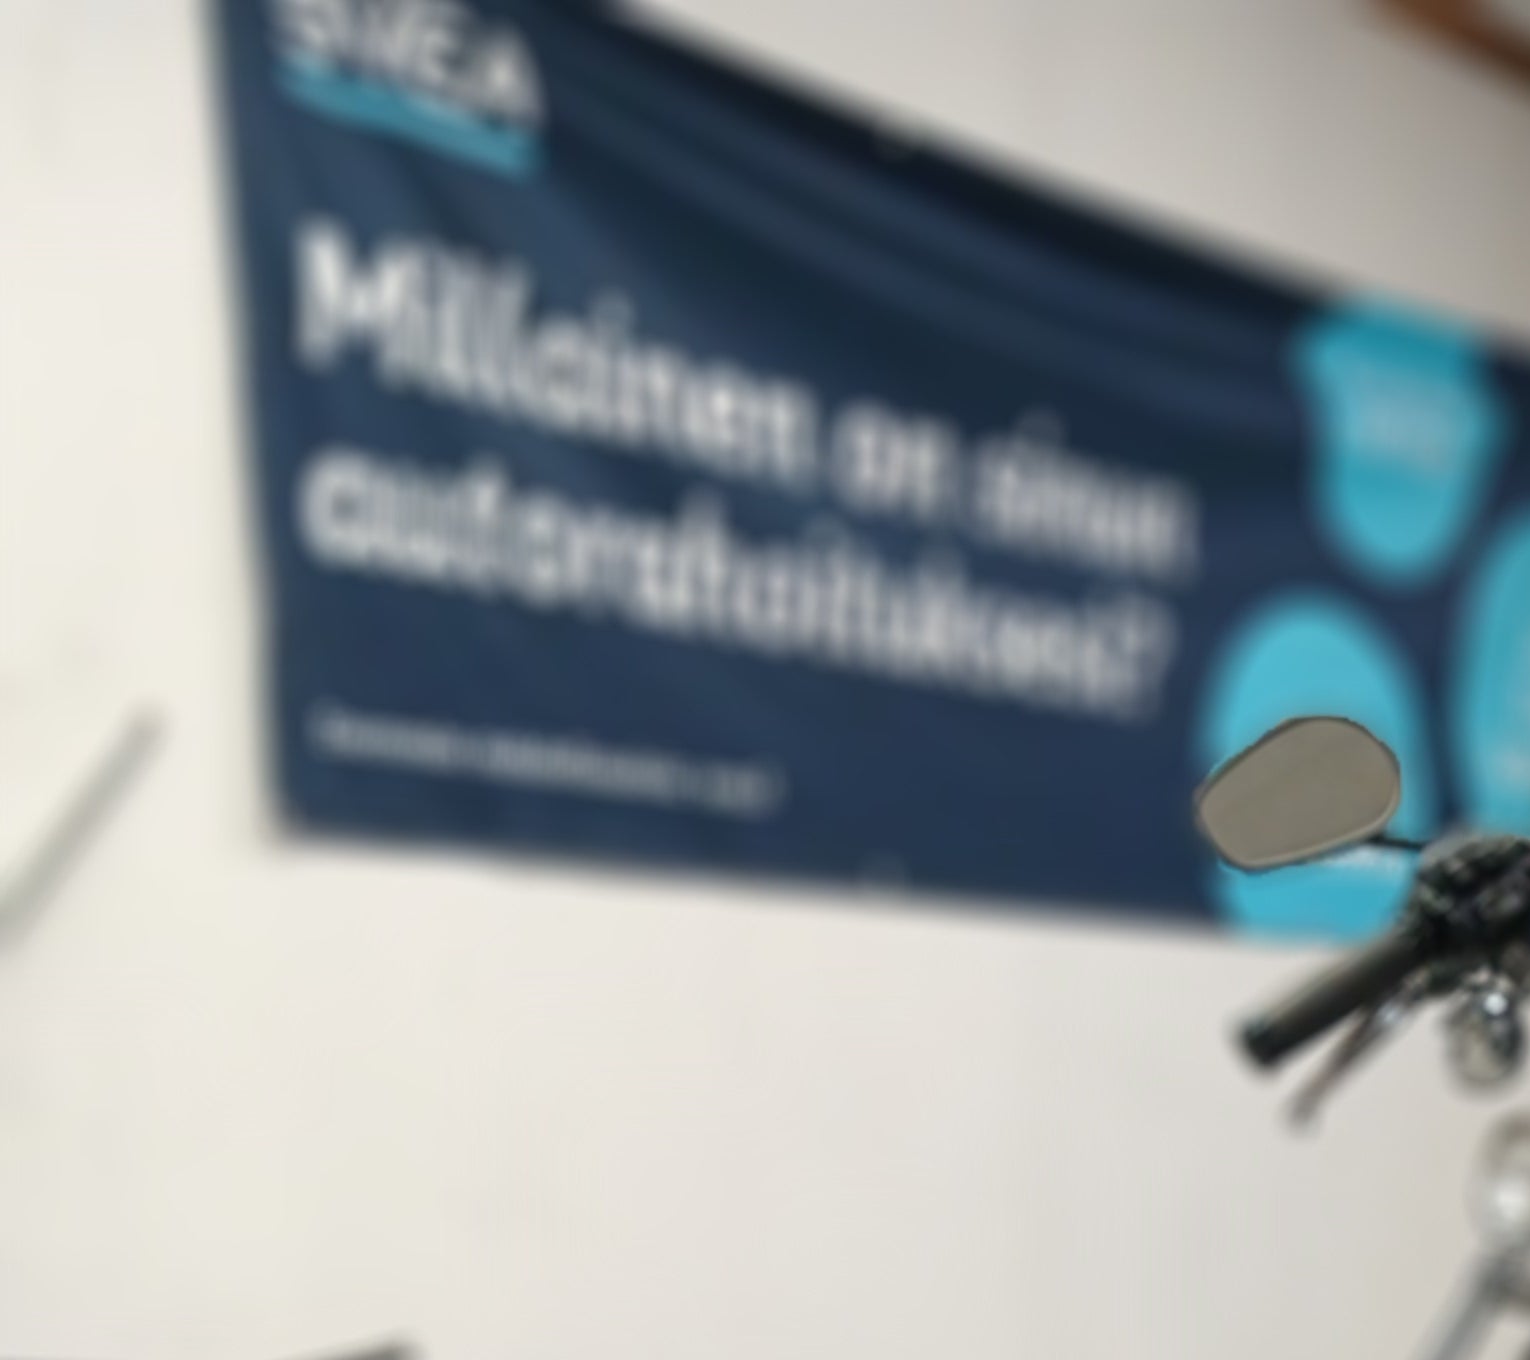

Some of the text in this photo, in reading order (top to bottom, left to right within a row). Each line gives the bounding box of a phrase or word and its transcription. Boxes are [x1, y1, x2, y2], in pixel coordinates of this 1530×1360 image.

[294, 218, 820, 492] Millainen
[832, 402, 960, 526] on
[972, 412, 1196, 590] sinun
